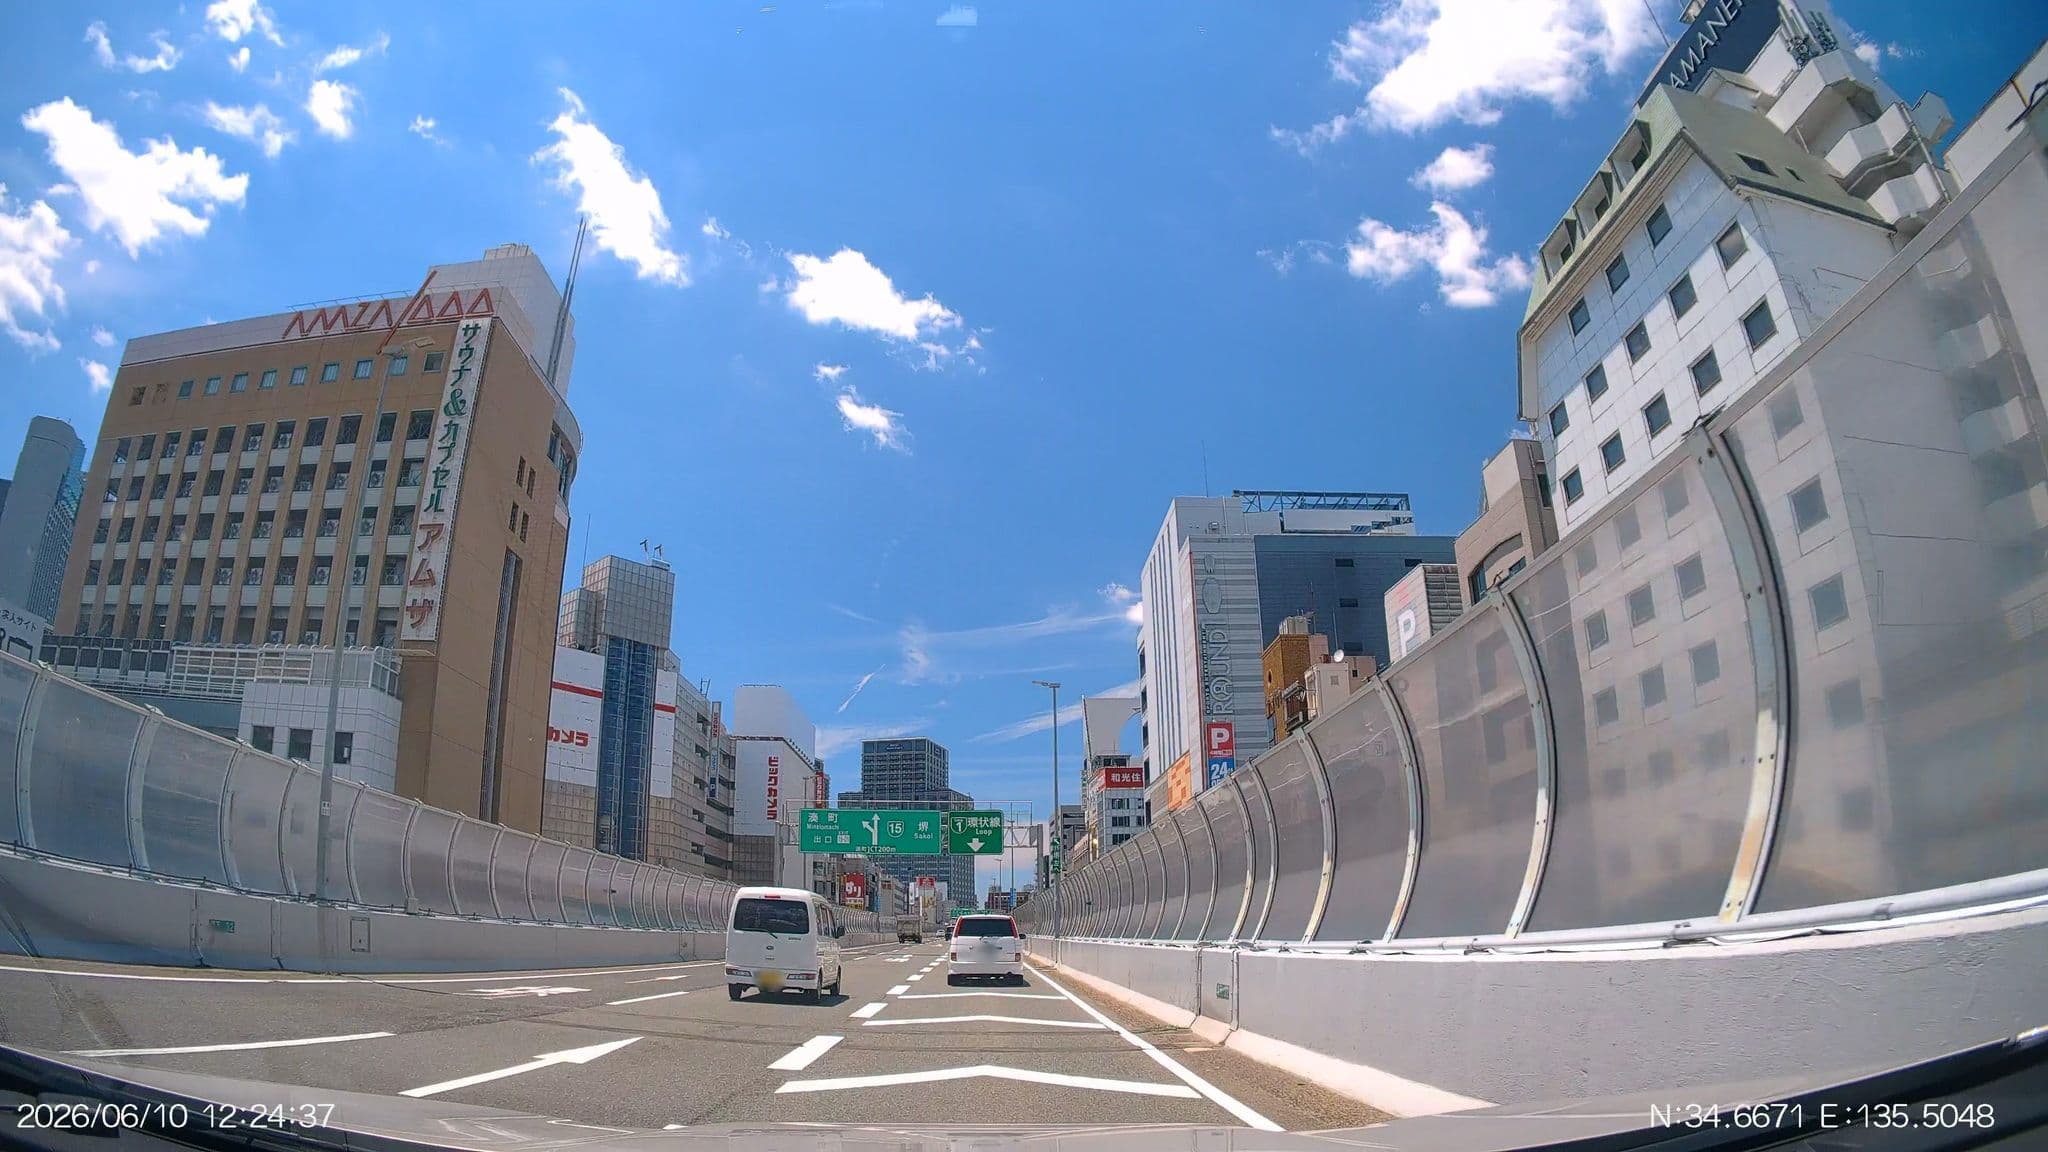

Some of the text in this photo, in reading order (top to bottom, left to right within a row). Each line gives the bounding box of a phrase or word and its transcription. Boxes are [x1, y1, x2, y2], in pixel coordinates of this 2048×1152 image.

[1670, 0, 1743, 89] AMANE
[1211, 728, 1230, 749] P
[918, 821, 929, 832] 堺
[967, 817, 1001, 828] 環状線
[888, 823, 902, 834] 15
[975, 828, 992, 836] Loop
